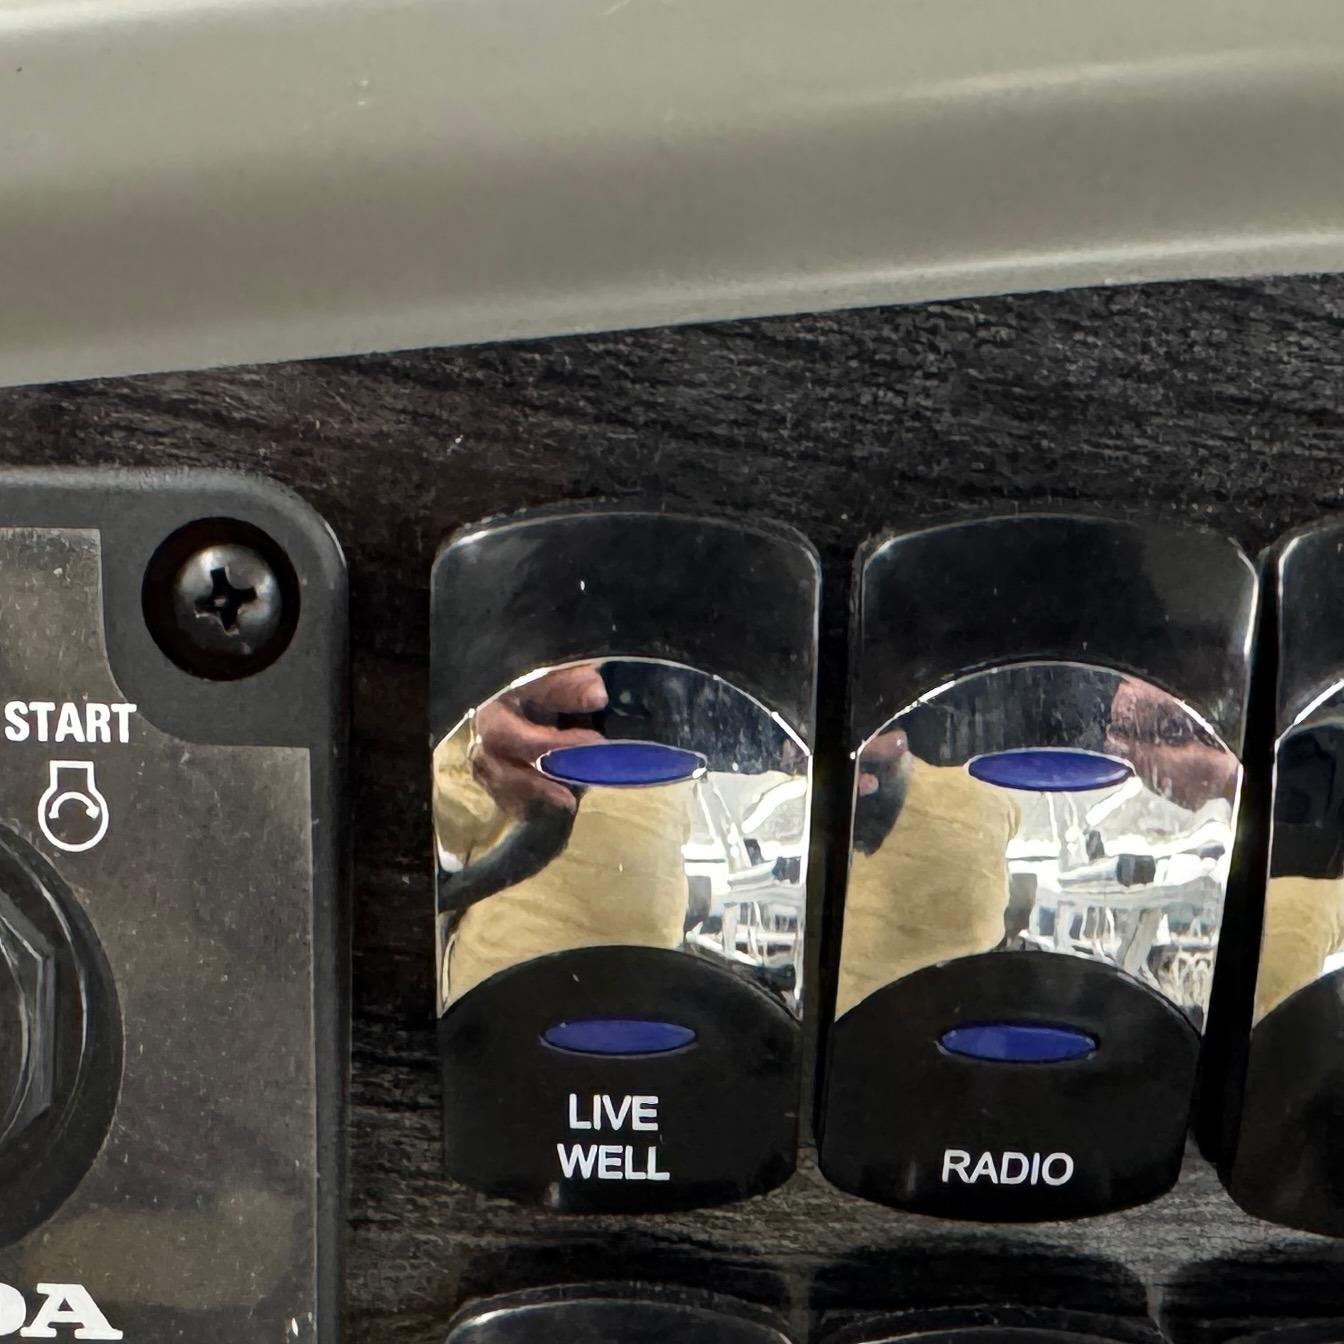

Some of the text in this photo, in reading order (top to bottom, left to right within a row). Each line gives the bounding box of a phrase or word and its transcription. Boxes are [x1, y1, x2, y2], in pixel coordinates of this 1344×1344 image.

[4, 700, 138, 744] START
[569, 1093, 659, 1131] LIVE
[556, 1143, 671, 1181] WELL
[941, 1149, 1074, 1186] RADIO
